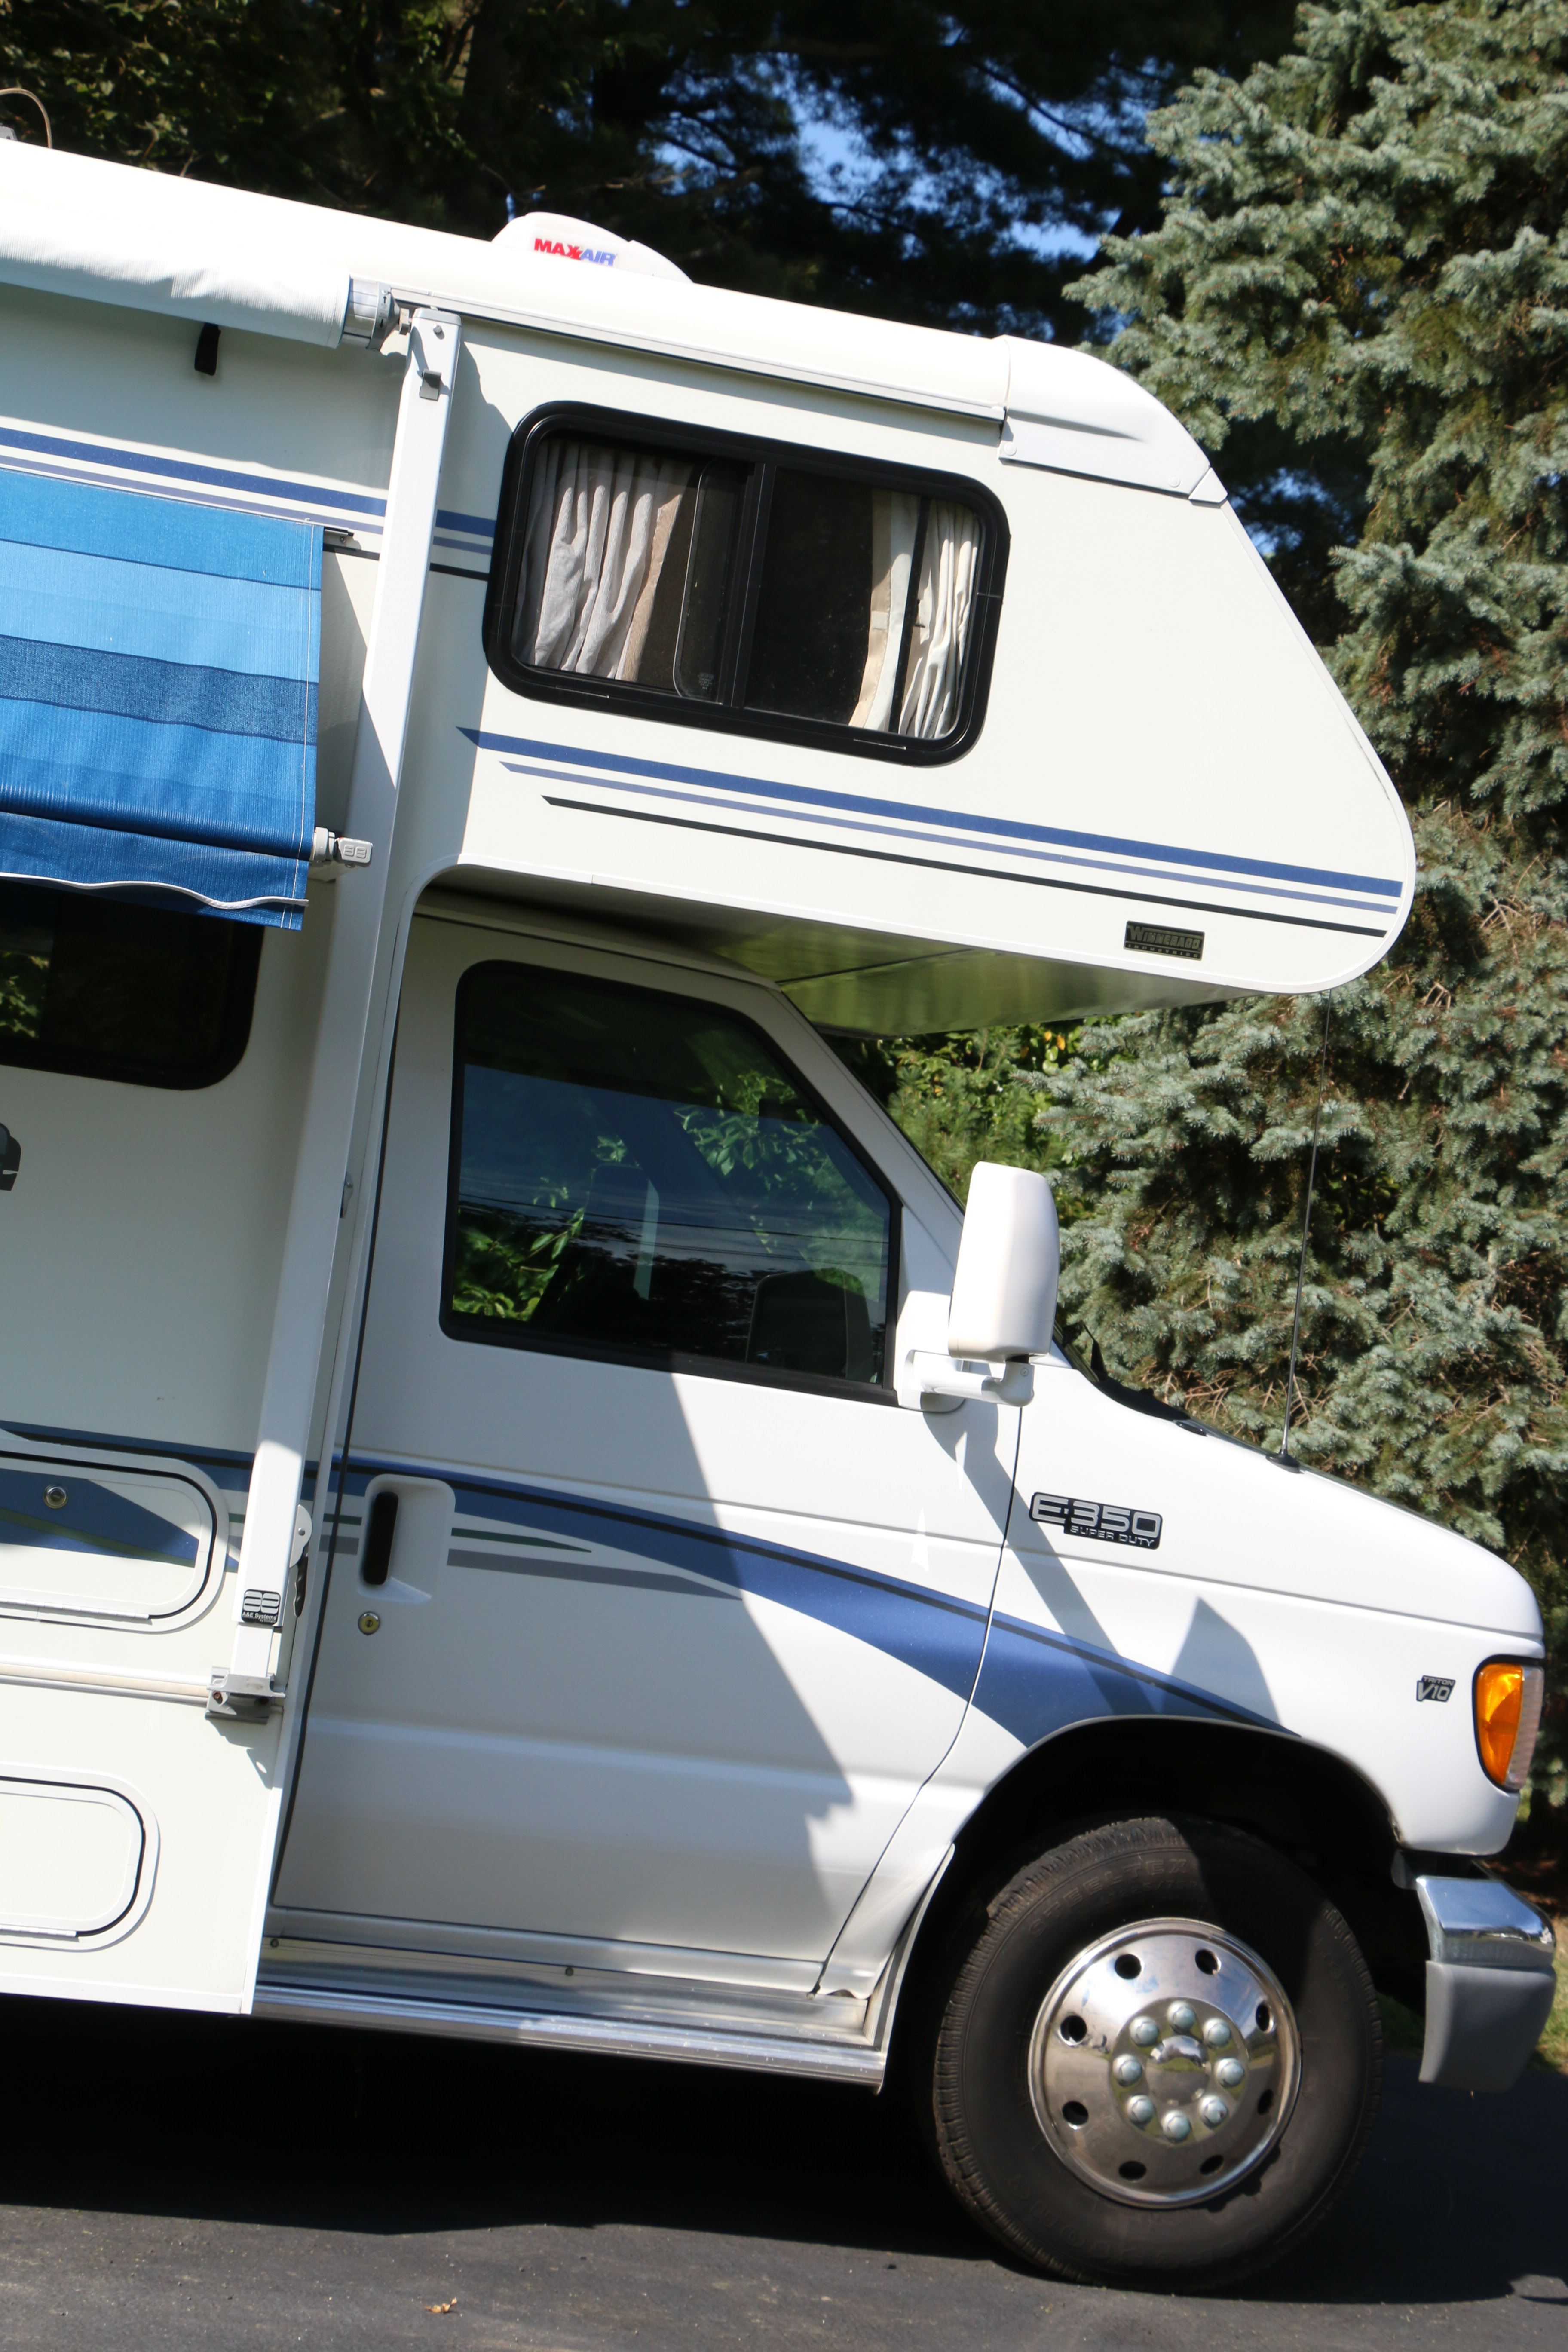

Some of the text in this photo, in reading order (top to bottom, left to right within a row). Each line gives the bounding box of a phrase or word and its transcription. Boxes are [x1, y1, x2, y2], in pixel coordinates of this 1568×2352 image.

[1127, 925, 1200, 949] WINNEBAGO
[1032, 1494, 1161, 1538] E-350
[1070, 1526, 1155, 1547] SUPER DUTY
[1418, 1681, 1450, 1701] V10
[1423, 1676, 1455, 1686] TRITON
